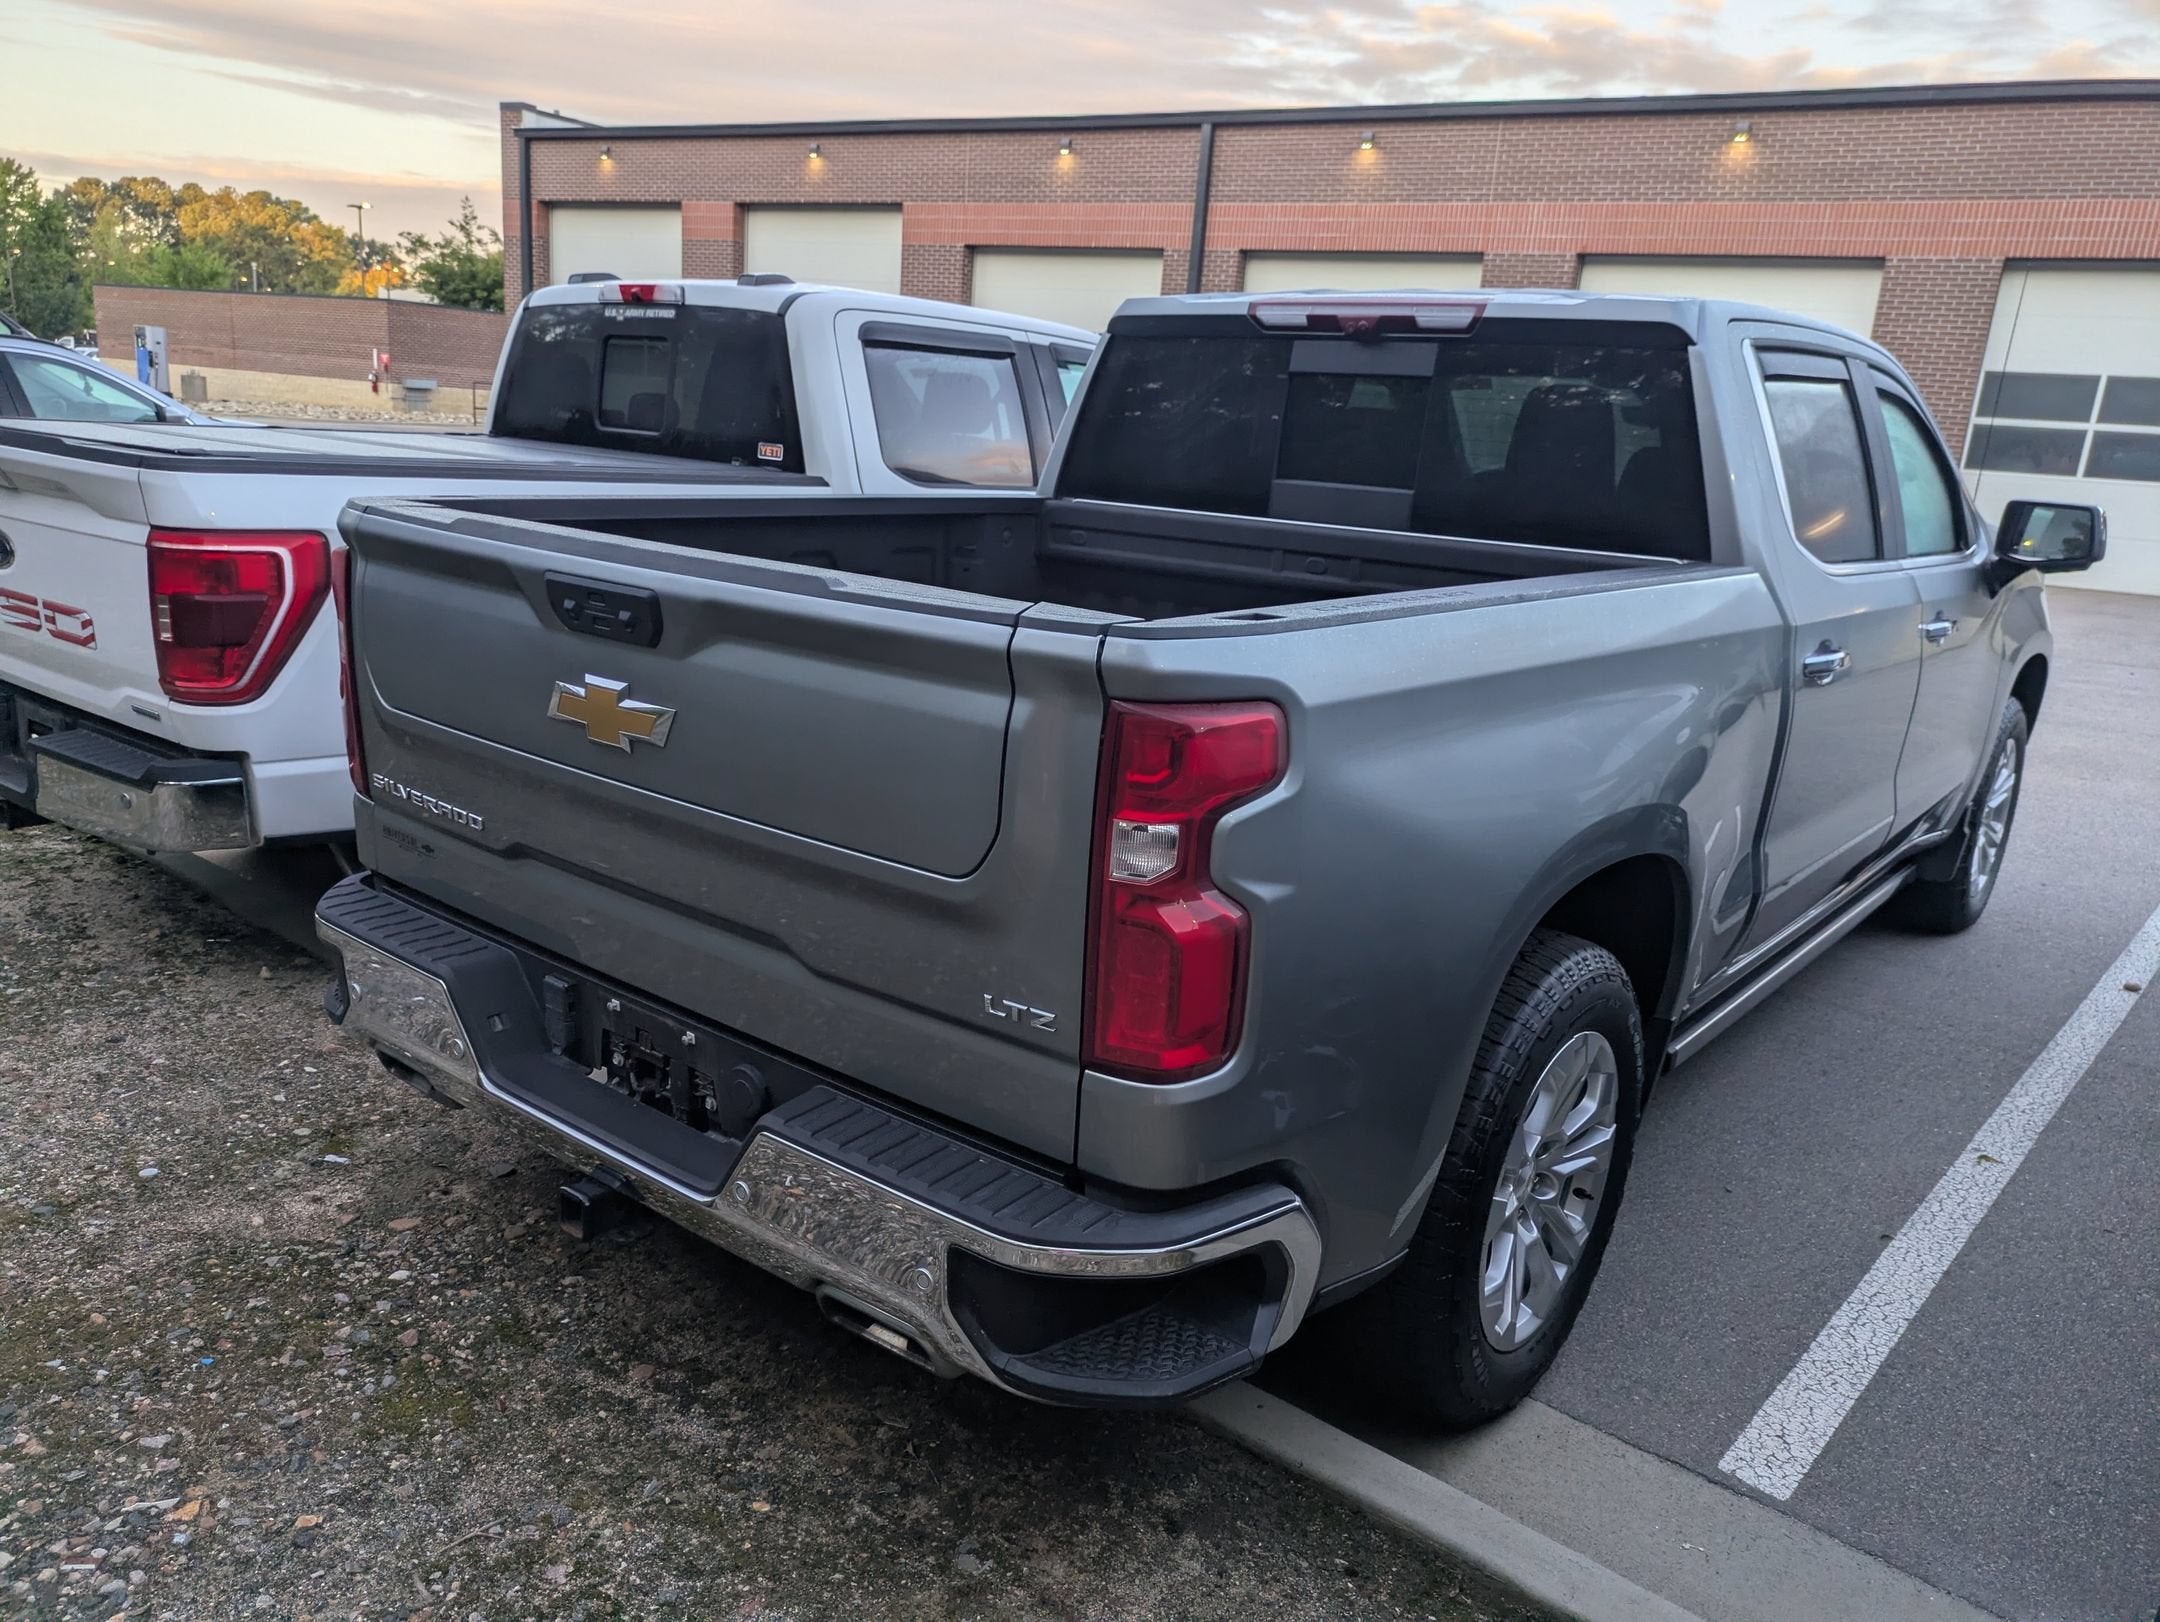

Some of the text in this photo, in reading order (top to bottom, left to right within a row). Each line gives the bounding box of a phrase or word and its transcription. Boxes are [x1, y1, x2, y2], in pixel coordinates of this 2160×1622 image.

[625, 308, 645, 319] ARMY
[646, 308, 676, 319] RETIRED
[760, 445, 781, 458] YETI
[372, 772, 485, 831] SILVERADO
[983, 993, 1057, 1032] LTZ
